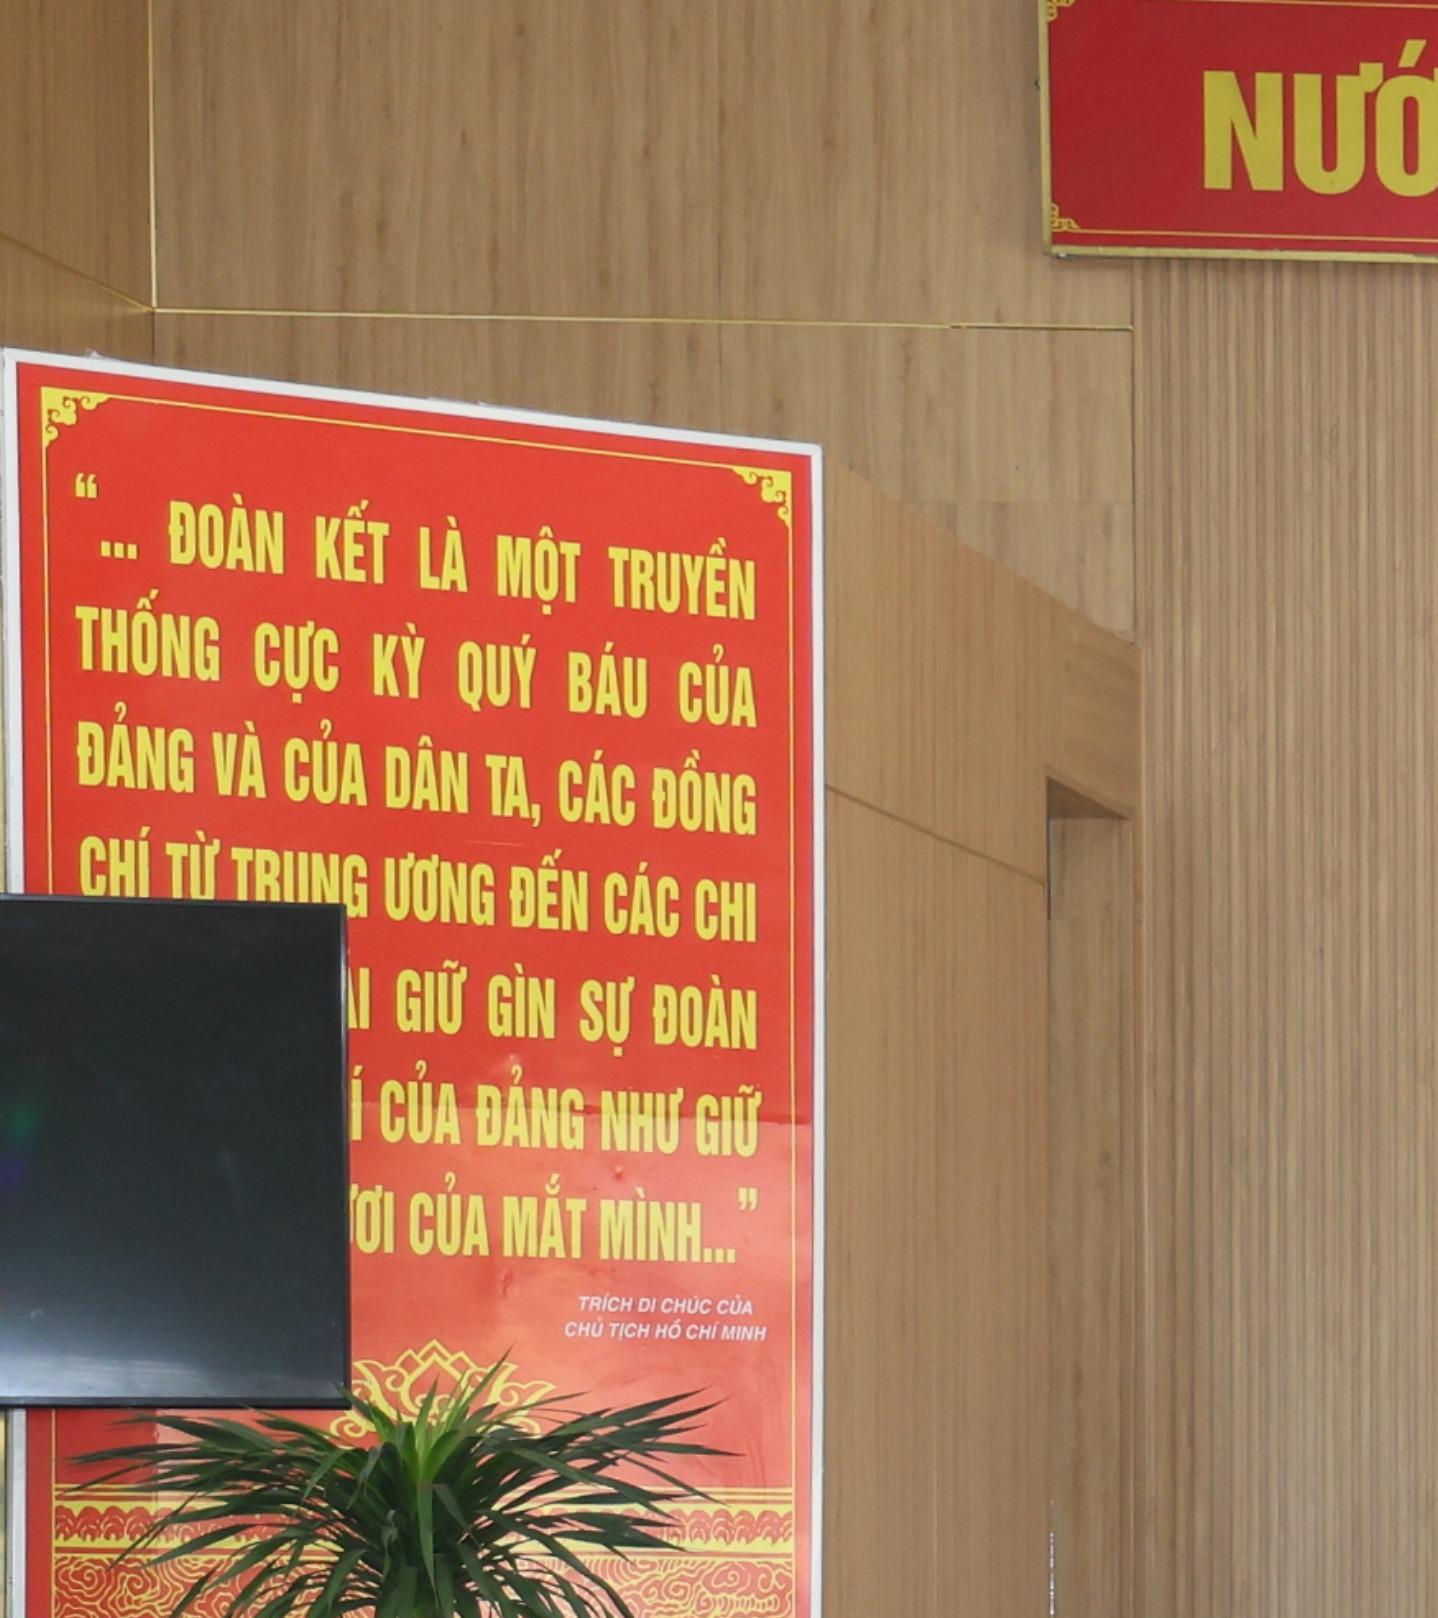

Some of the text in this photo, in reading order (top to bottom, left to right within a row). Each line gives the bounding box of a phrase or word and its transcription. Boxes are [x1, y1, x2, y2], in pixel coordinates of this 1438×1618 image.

[168, 494, 284, 573] ĐOÀN
[315, 501, 390, 583] KẾT
[419, 517, 467, 592] LÀ
[496, 527, 581, 614] MỘT
[608, 538, 755, 620] TRUYỀN
[384, 853, 495, 926] ƯƠNG
[509, 850, 588, 931] ĐẾN
[604, 863, 679, 937] CÁC
[694, 880, 756, 942] CHI
[396, 960, 467, 1035] GIỮ
[487, 965, 555, 1039] GÌN
[579, 976, 635, 1056] SỰ
[652, 976, 757, 1049] ĐOÀN
[378, 1061, 461, 1145] CỦA
[474, 1066, 585, 1149] ĐẢNG
[599, 1088, 684, 1153] NHƯ
[695, 1085, 762, 1157] GIỮ
[408, 1172, 490, 1256] CỦA
[501, 1174, 586, 1259] MẮT
[565, 1317, 603, 1337] CHỦ
[609, 1323, 649, 1340] TỊCH
[686, 1324, 717, 1339] CHÍ
[721, 1326, 766, 1340] MINH
[579, 1295, 752, 1315] TRÍCH DI CHÚC CỦA
